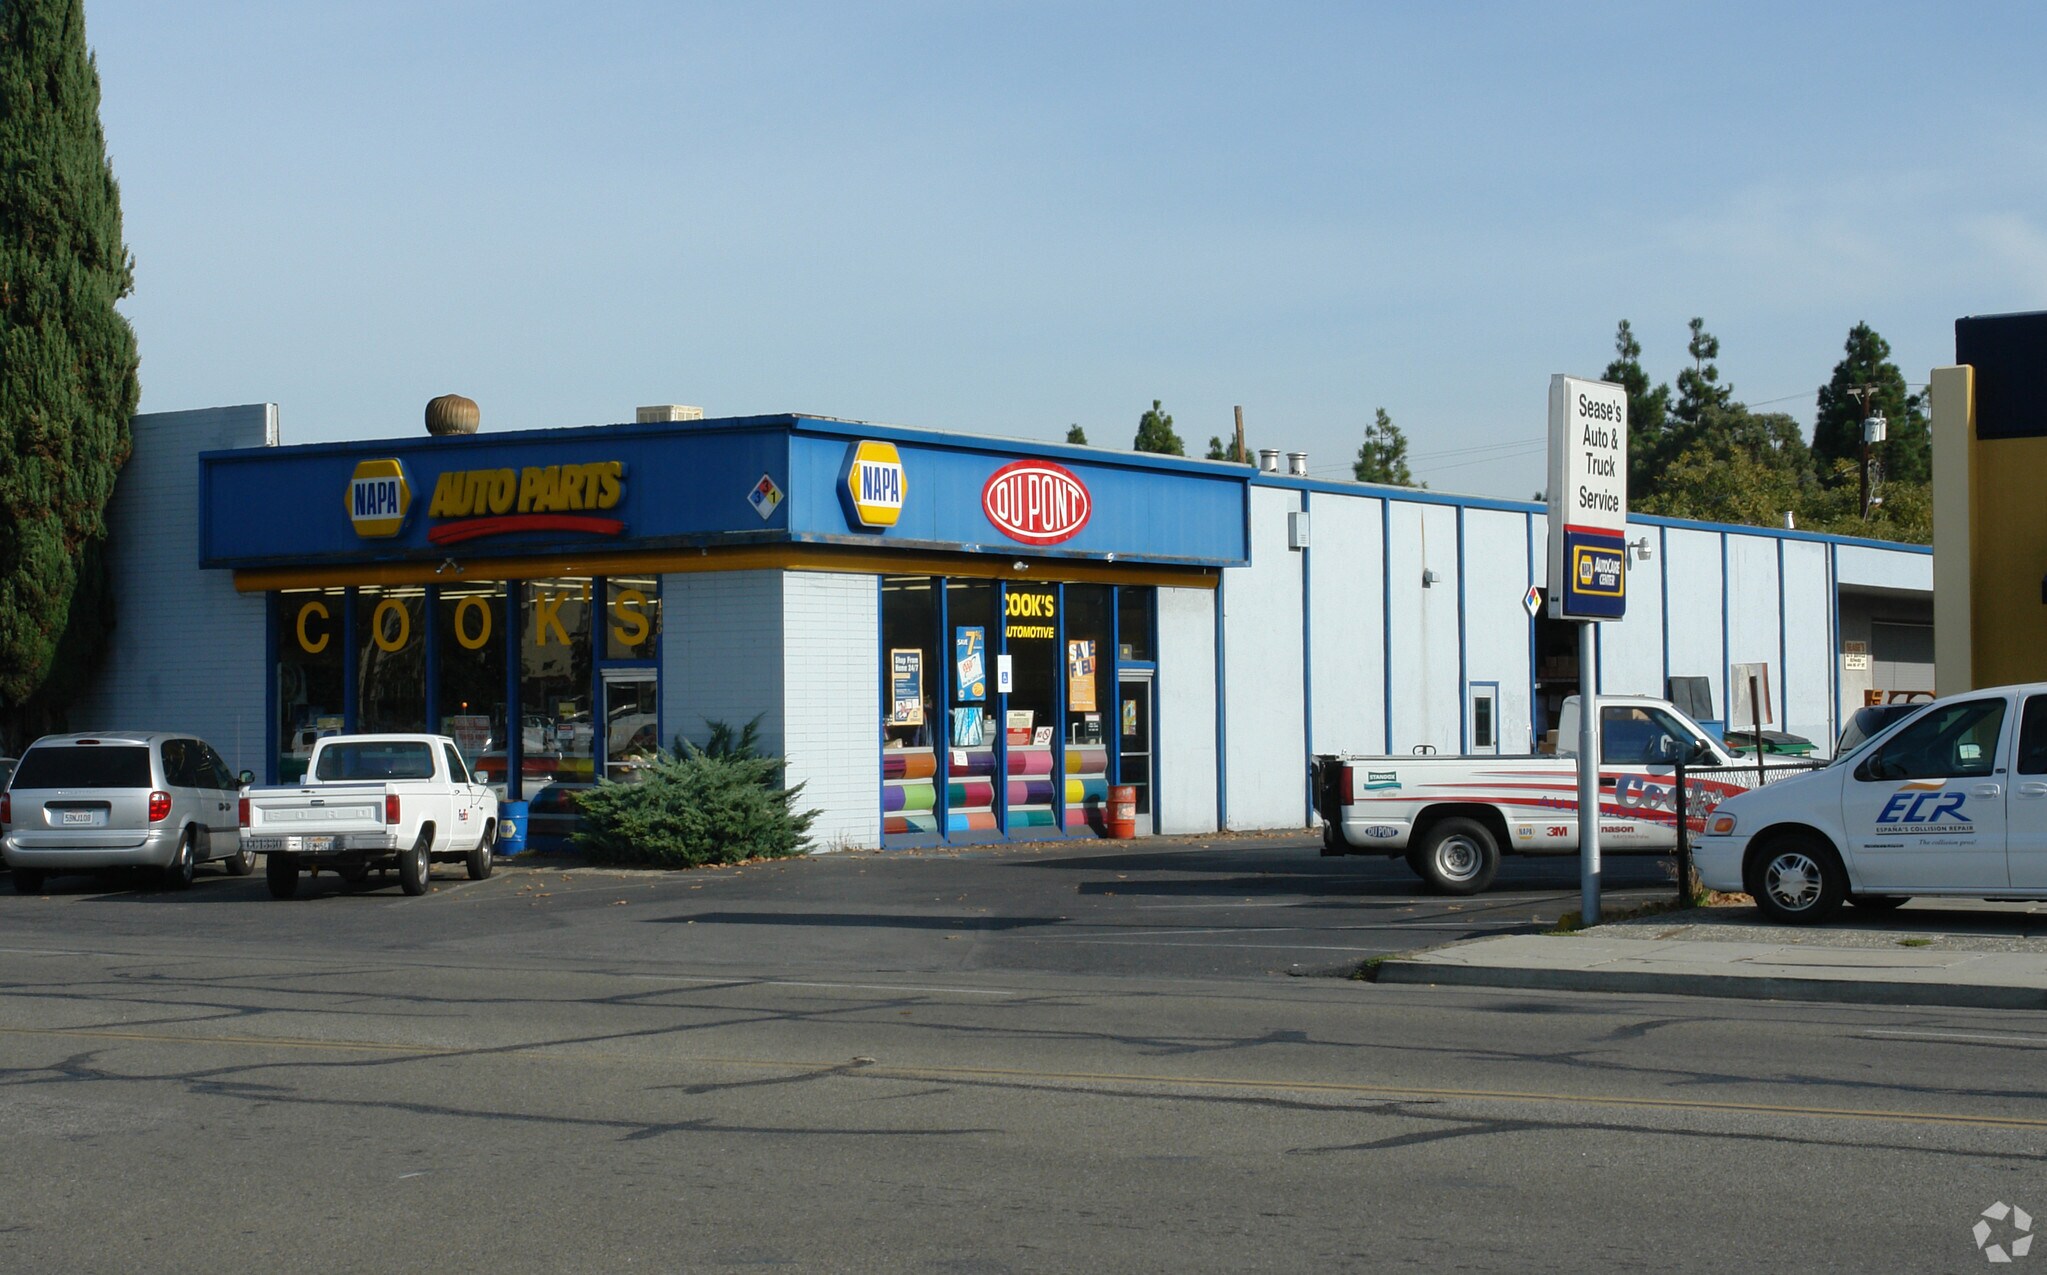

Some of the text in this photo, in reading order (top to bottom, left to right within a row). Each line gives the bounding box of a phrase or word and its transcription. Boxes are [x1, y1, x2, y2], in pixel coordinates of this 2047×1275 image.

[1579, 393, 1622, 423] Sease's
[1582, 424, 1618, 450] Auto &
[1585, 452, 1615, 477] Truck
[354, 460, 623, 518] NAPA AUTO PARTS
[863, 465, 900, 503] NAPA
[770, 490, 776, 504] 1
[997, 474, 1080, 532] DU PONT
[1579, 485, 1619, 512] Service
[1006, 625, 1054, 638] UTOMOTIVE
[1069, 640, 1095, 661] SAVE
[908, 664, 919, 672] 24/7
[1369, 773, 1396, 781] STANDOX
[1876, 792, 1972, 823] ECR
[1367, 827, 1396, 838] DU PONT
[1546, 826, 1568, 837] 3M
[1600, 825, 1635, 833] nason
[1876, 825, 1909, 833] ESPAÑA'S
